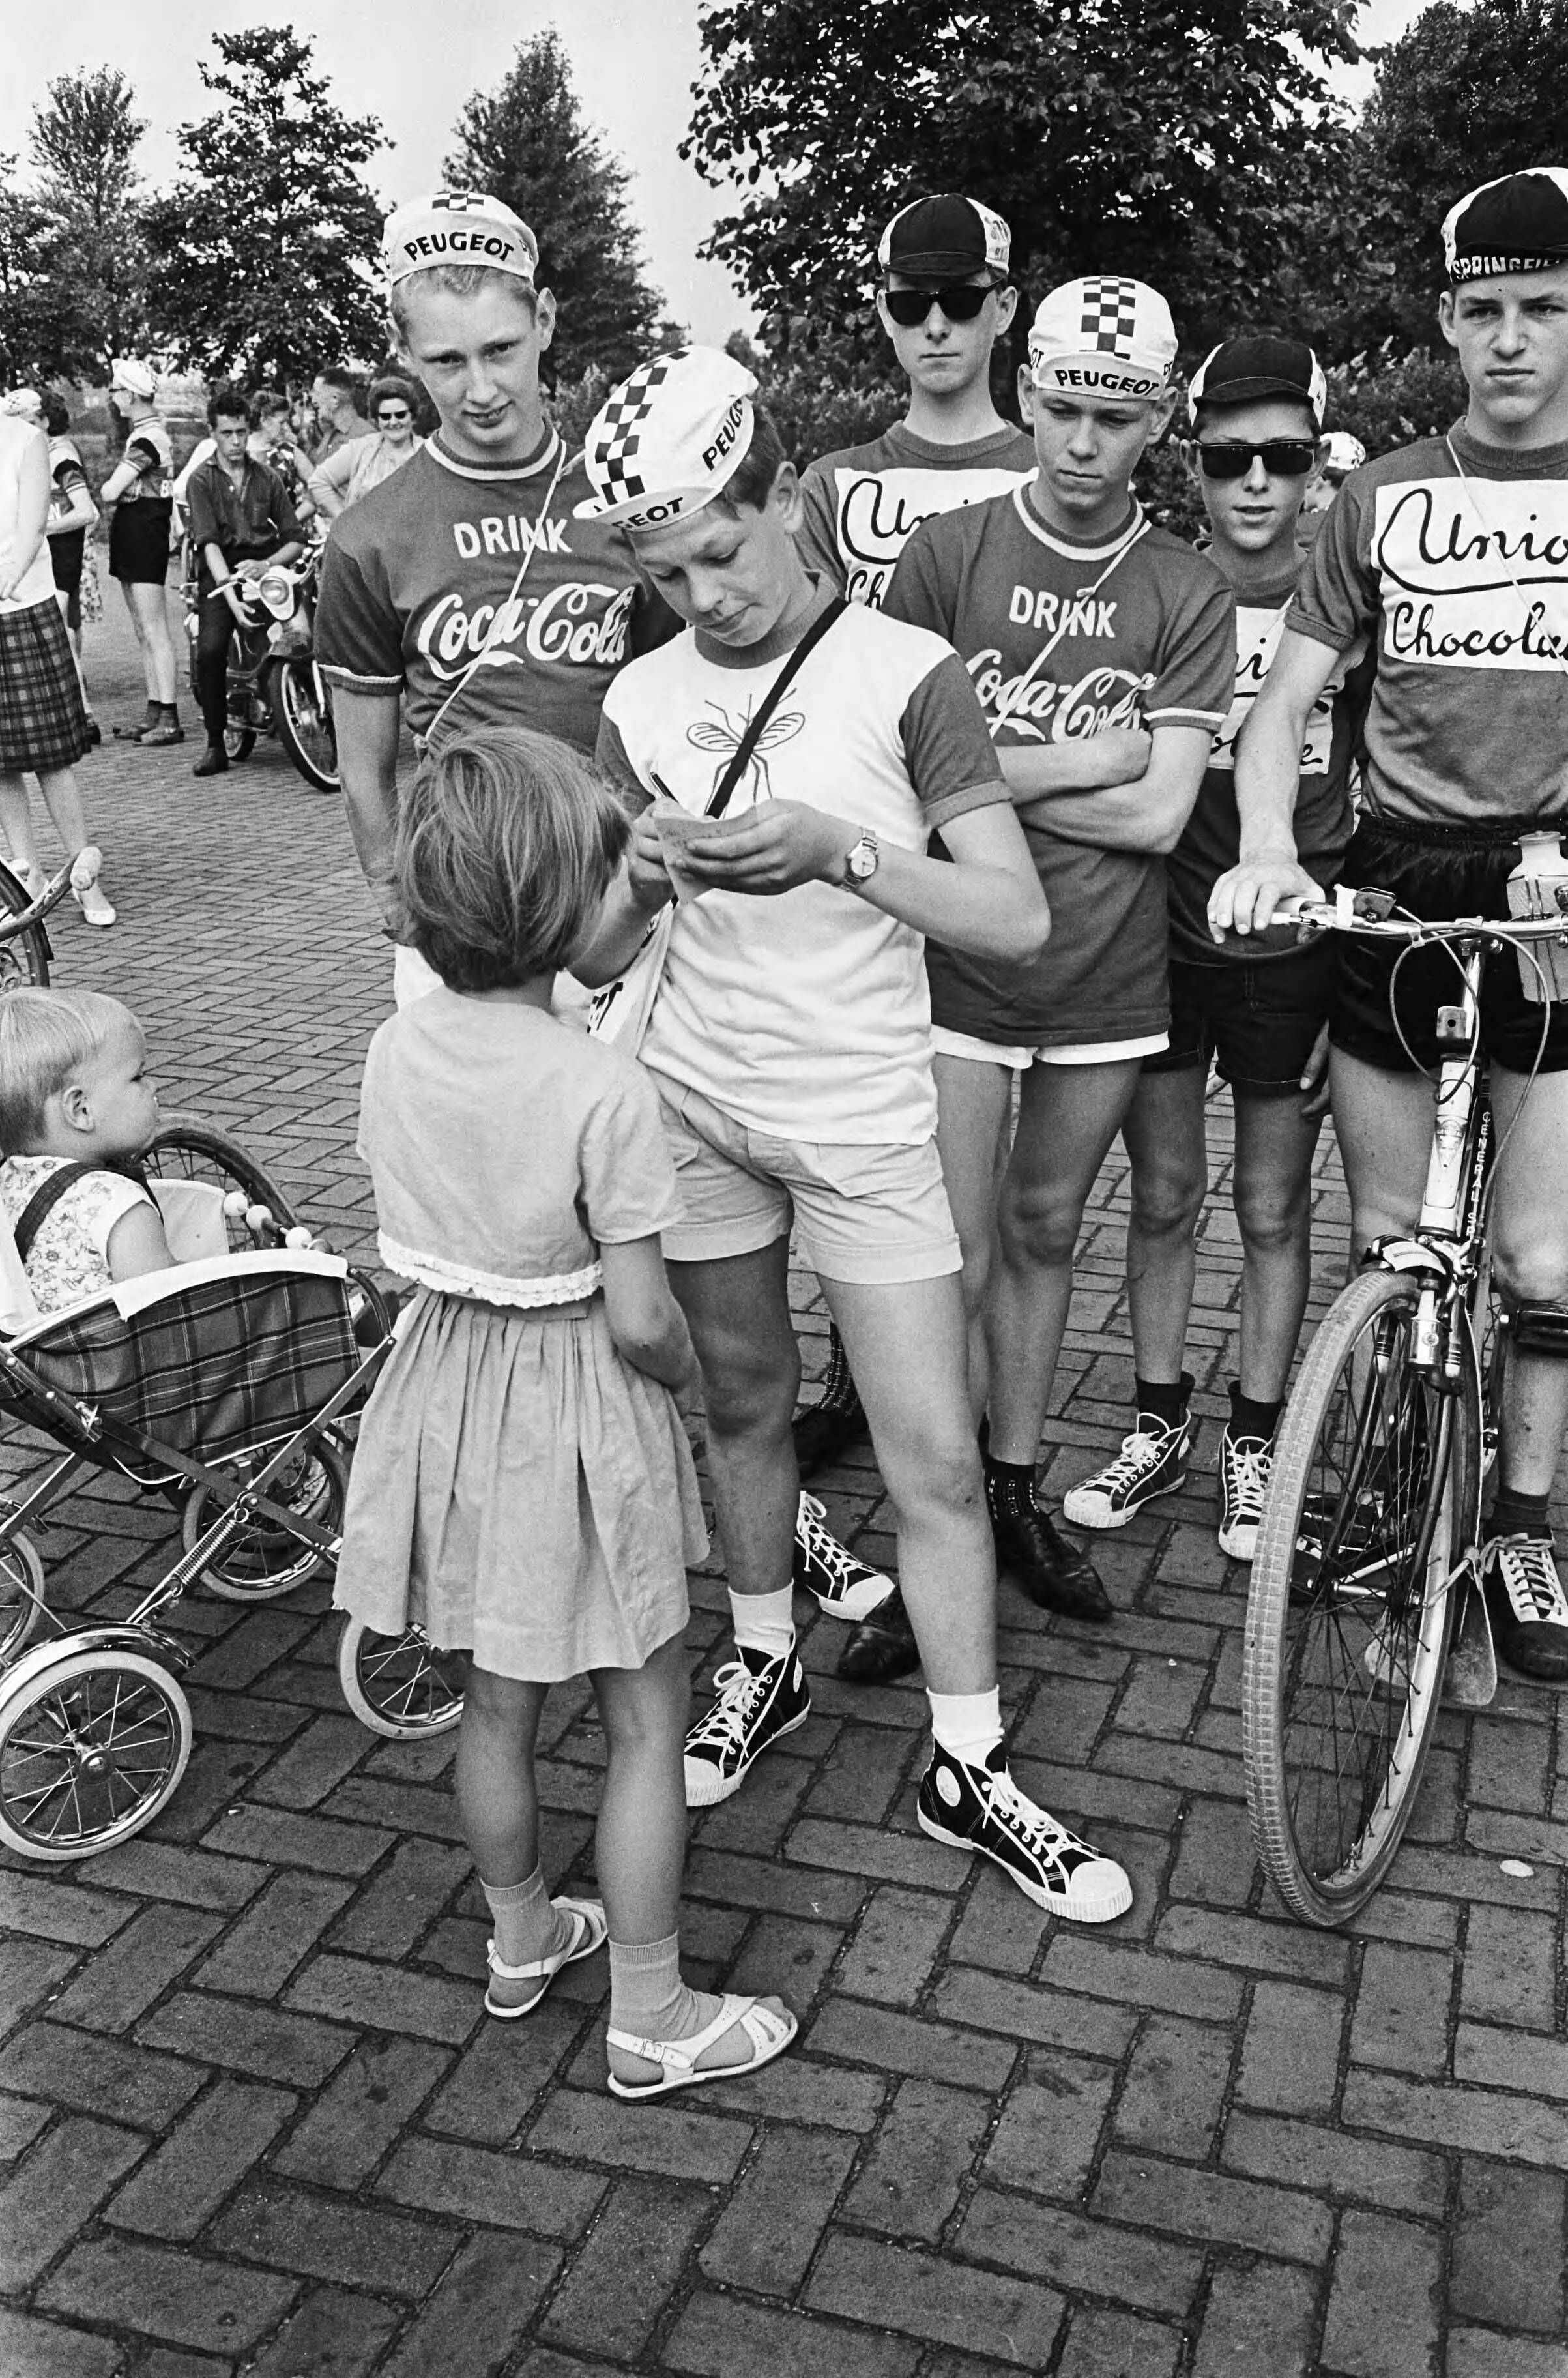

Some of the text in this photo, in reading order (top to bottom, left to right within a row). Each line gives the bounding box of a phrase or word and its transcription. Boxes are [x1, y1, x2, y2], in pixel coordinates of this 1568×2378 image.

[404, 232, 514, 261] PEUGEOT
[1054, 370, 1159, 396] PEUGEOT
[454, 516, 572, 558] DRINK
[417, 583, 635, 680] Coca-Cola
[1010, 585, 1117, 638] DRINK
[1393, 602, 1568, 659] Chocola
